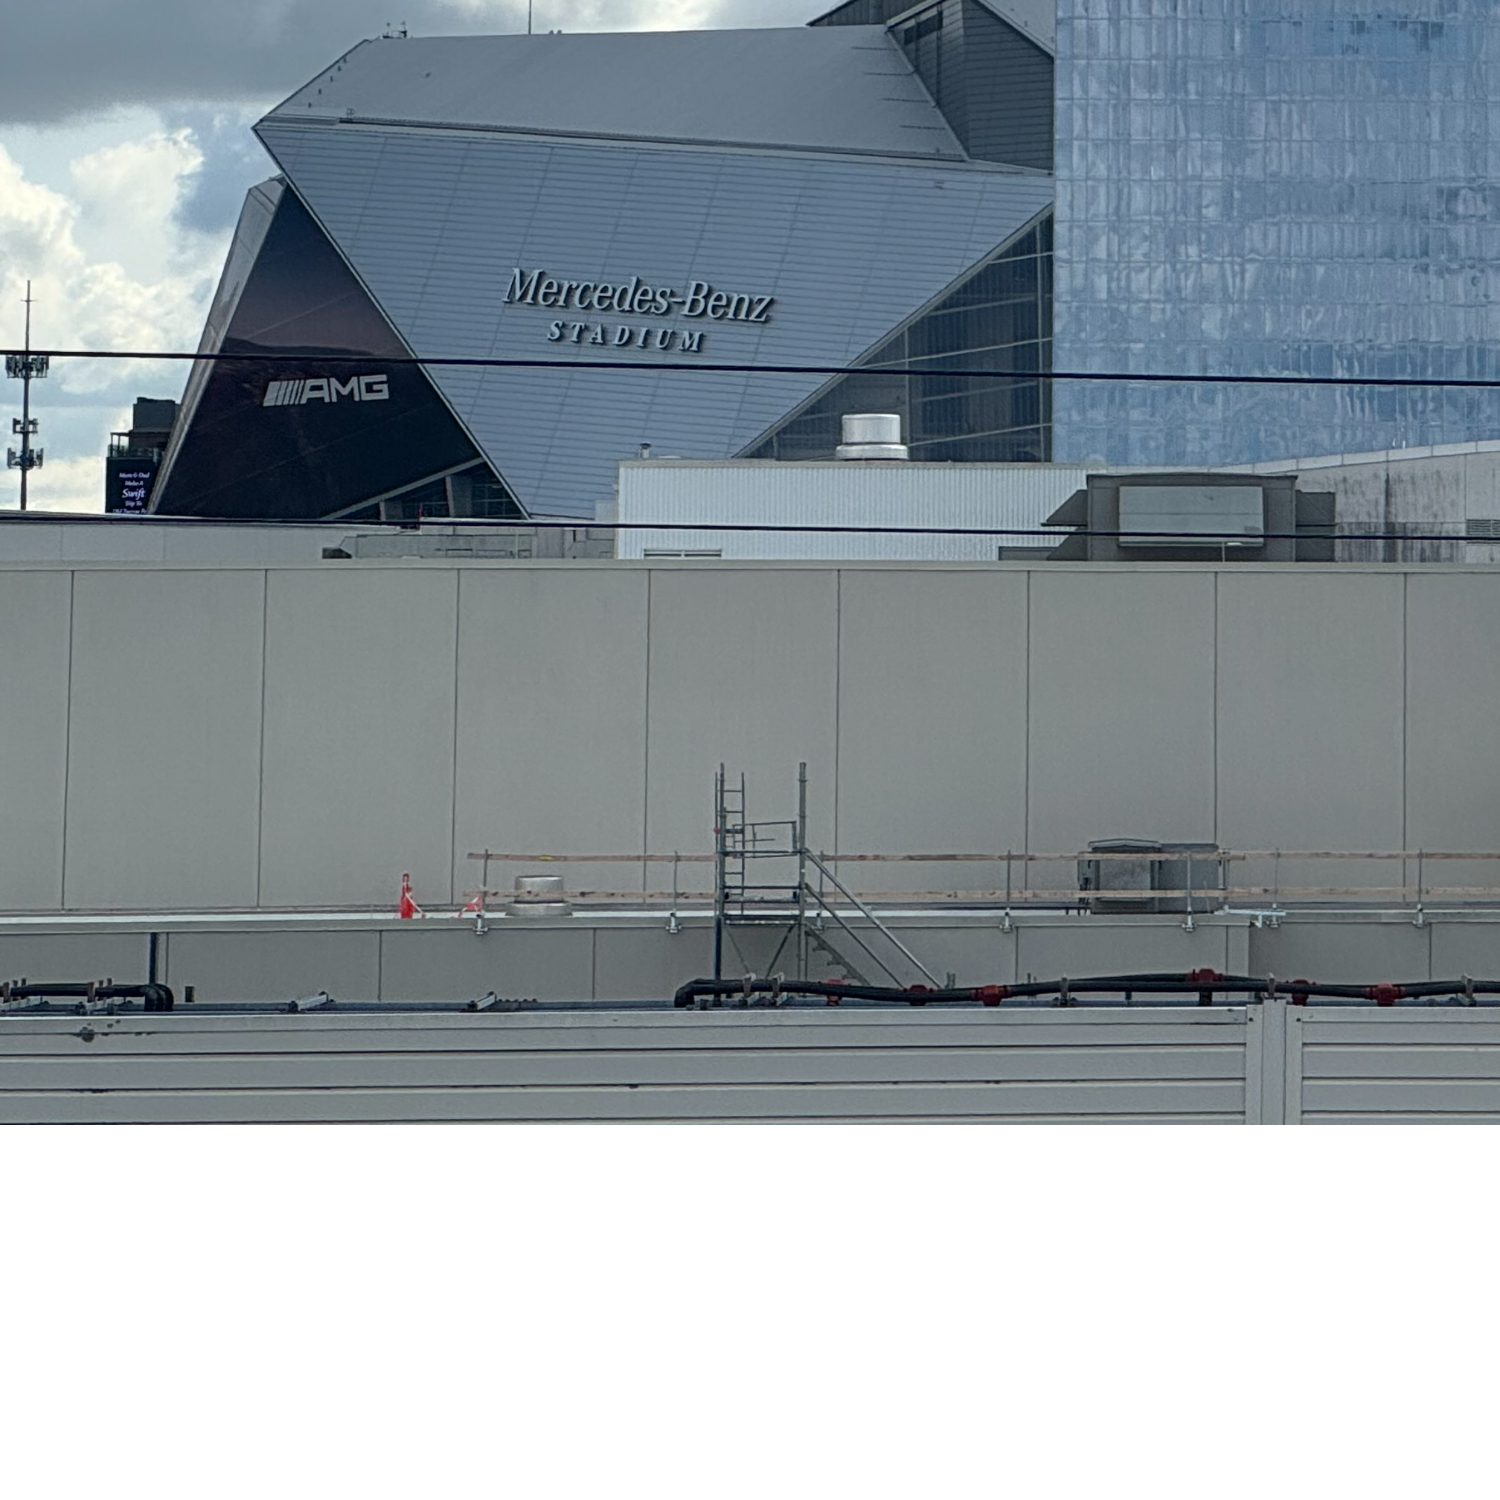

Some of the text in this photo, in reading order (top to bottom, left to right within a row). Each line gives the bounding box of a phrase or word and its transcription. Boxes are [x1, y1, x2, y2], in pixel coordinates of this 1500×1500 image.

[502, 267, 774, 323] Mercedes-Benz
[547, 320, 704, 351] STADIUM
[300, 374, 390, 405] AMG
